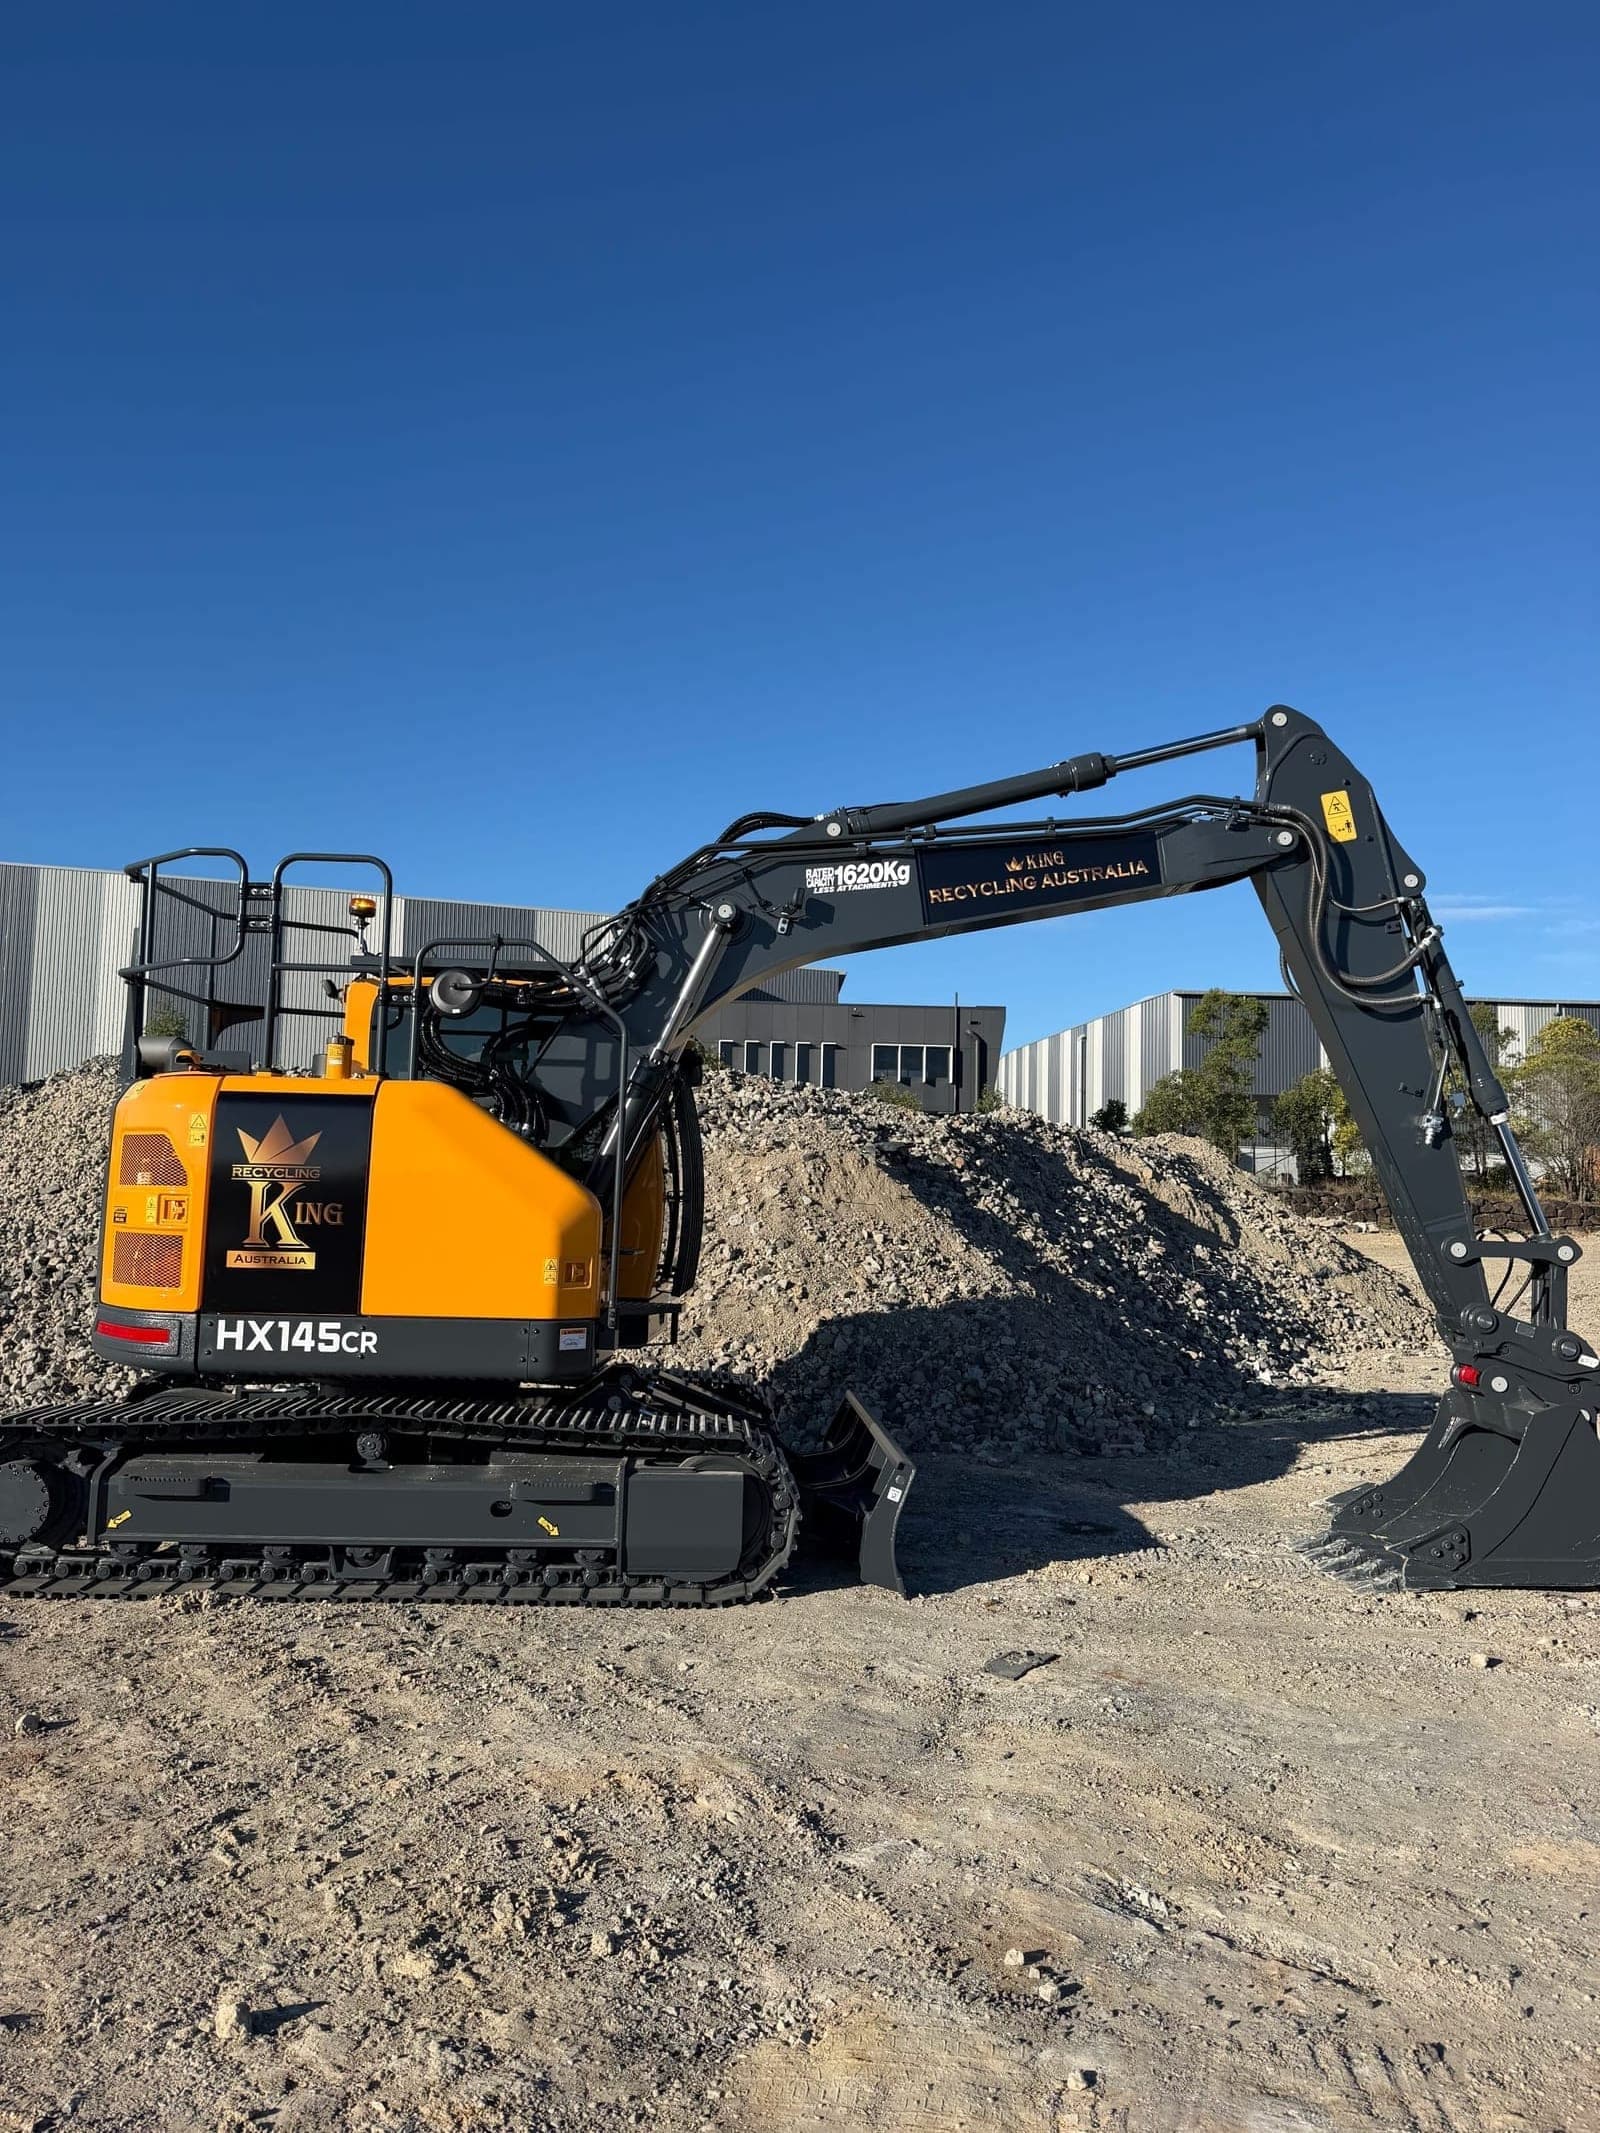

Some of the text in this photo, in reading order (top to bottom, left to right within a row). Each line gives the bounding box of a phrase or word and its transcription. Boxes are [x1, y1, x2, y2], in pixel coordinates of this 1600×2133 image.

[1026, 851, 1065, 870] KING
[805, 867, 834, 880] RATED
[834, 860, 910, 886] 1620Kg
[806, 875, 834, 888] CAPACITY
[814, 880, 899, 894] LESS ATTACHMENTS
[929, 860, 1149, 904] RECYCLING AUSTRALIA
[231, 1166, 321, 1179] RECYCLING
[233, 1253, 307, 1265] AUSTRALIA
[216, 1319, 379, 1354] HX145CR
